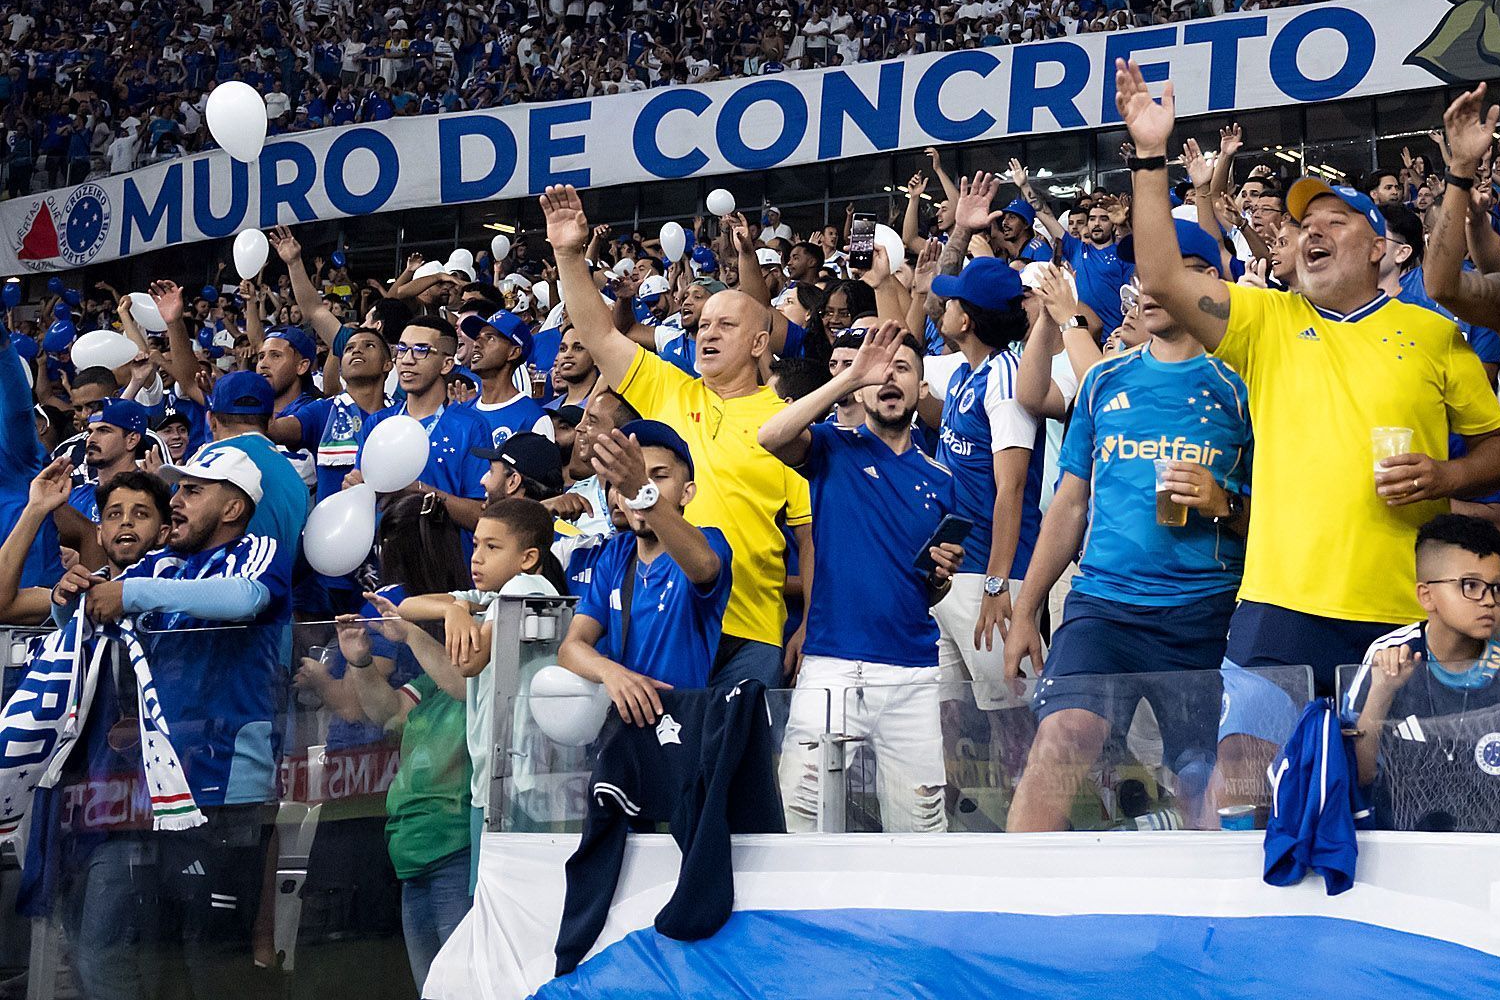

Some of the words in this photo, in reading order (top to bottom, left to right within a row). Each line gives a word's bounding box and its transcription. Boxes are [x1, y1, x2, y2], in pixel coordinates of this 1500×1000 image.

[119, 127, 400, 257] MURO
[438, 101, 592, 205] DE
[632, 6, 1377, 179] CONCRETO
[65, 185, 107, 214] CRUZEIRO
[59, 221, 86, 264] ESPORTE
[87, 211, 110, 258] CLUBE
[1118, 433, 1223, 466] betfair
